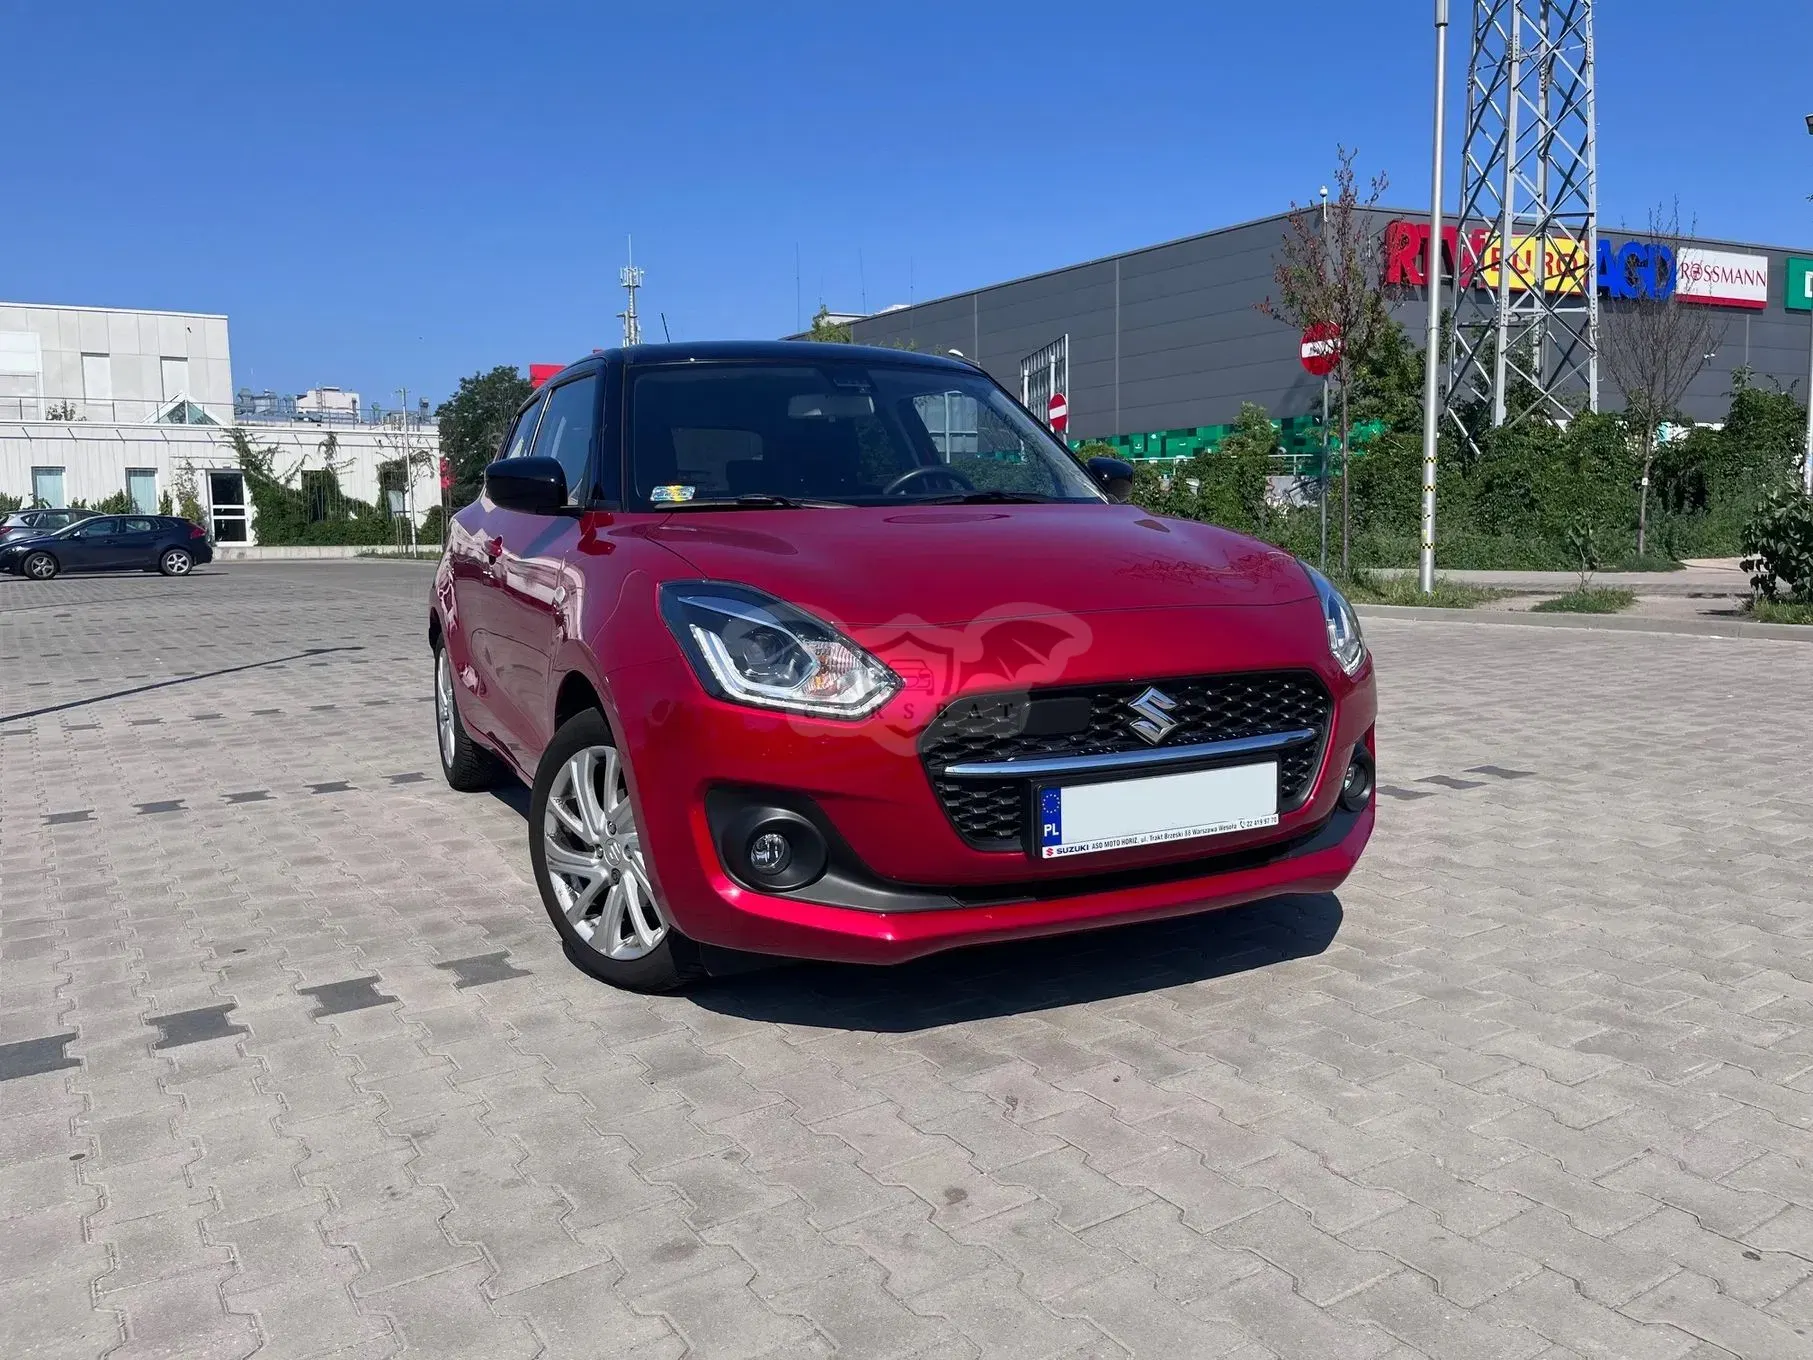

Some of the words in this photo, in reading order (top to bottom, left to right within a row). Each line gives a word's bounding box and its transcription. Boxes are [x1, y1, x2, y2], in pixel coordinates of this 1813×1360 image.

[1490, 247, 1578, 278] EURO
[1597, 240, 1675, 301] AGD
[1680, 261, 1767, 288] ROSSMANN
[1043, 823, 1060, 837] PL
[1056, 844, 1089, 855] SUZUKI
[1092, 842, 1103, 850] ASO
[1104, 839, 1120, 848] MOTO
[1192, 826, 1217, 836] Warszawa
